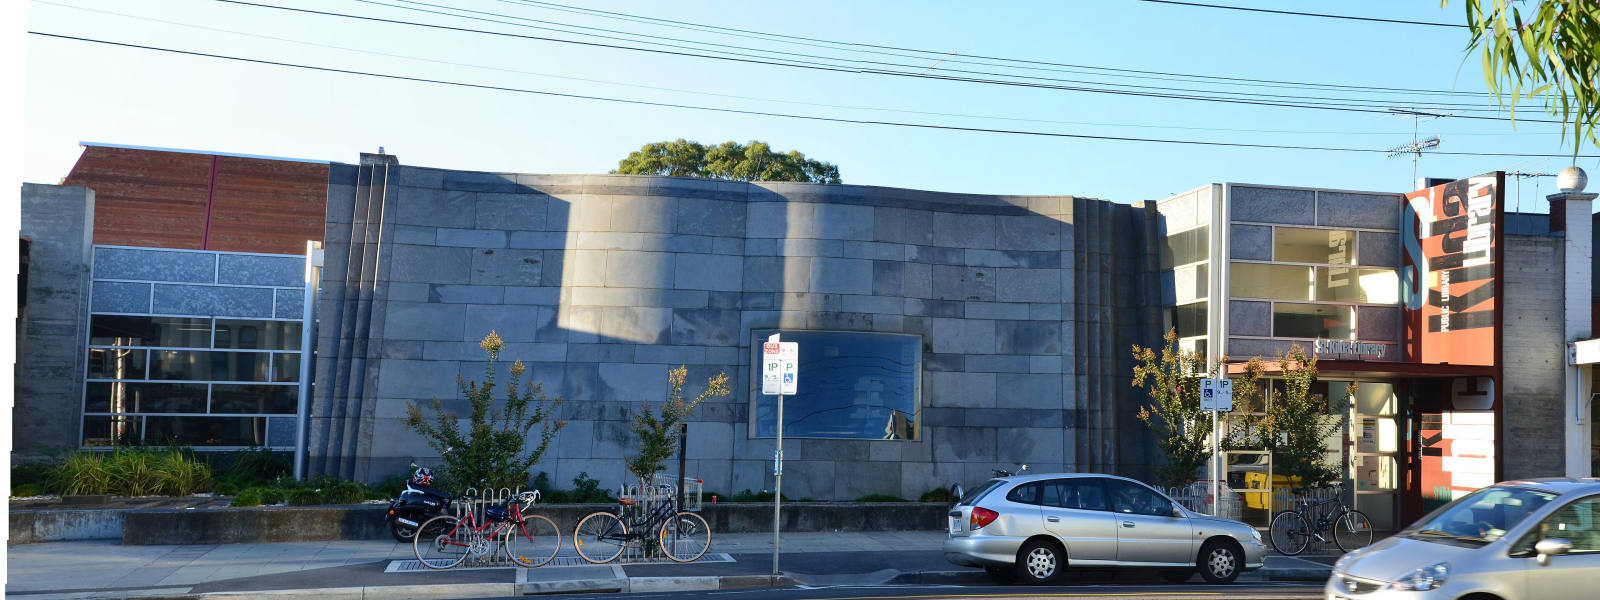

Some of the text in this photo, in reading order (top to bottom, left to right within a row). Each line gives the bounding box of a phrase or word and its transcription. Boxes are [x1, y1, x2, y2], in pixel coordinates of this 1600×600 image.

[1463, 176, 1497, 268] Library
[1440, 270, 1450, 333] PUBLIC LIBRARY
[1315, 339, 1386, 358] St Kilda Library
[768, 362, 778, 371] 1P
[786, 362, 793, 371] P
[1205, 380, 1212, 388] P
[1219, 380, 1229, 388] 1P
